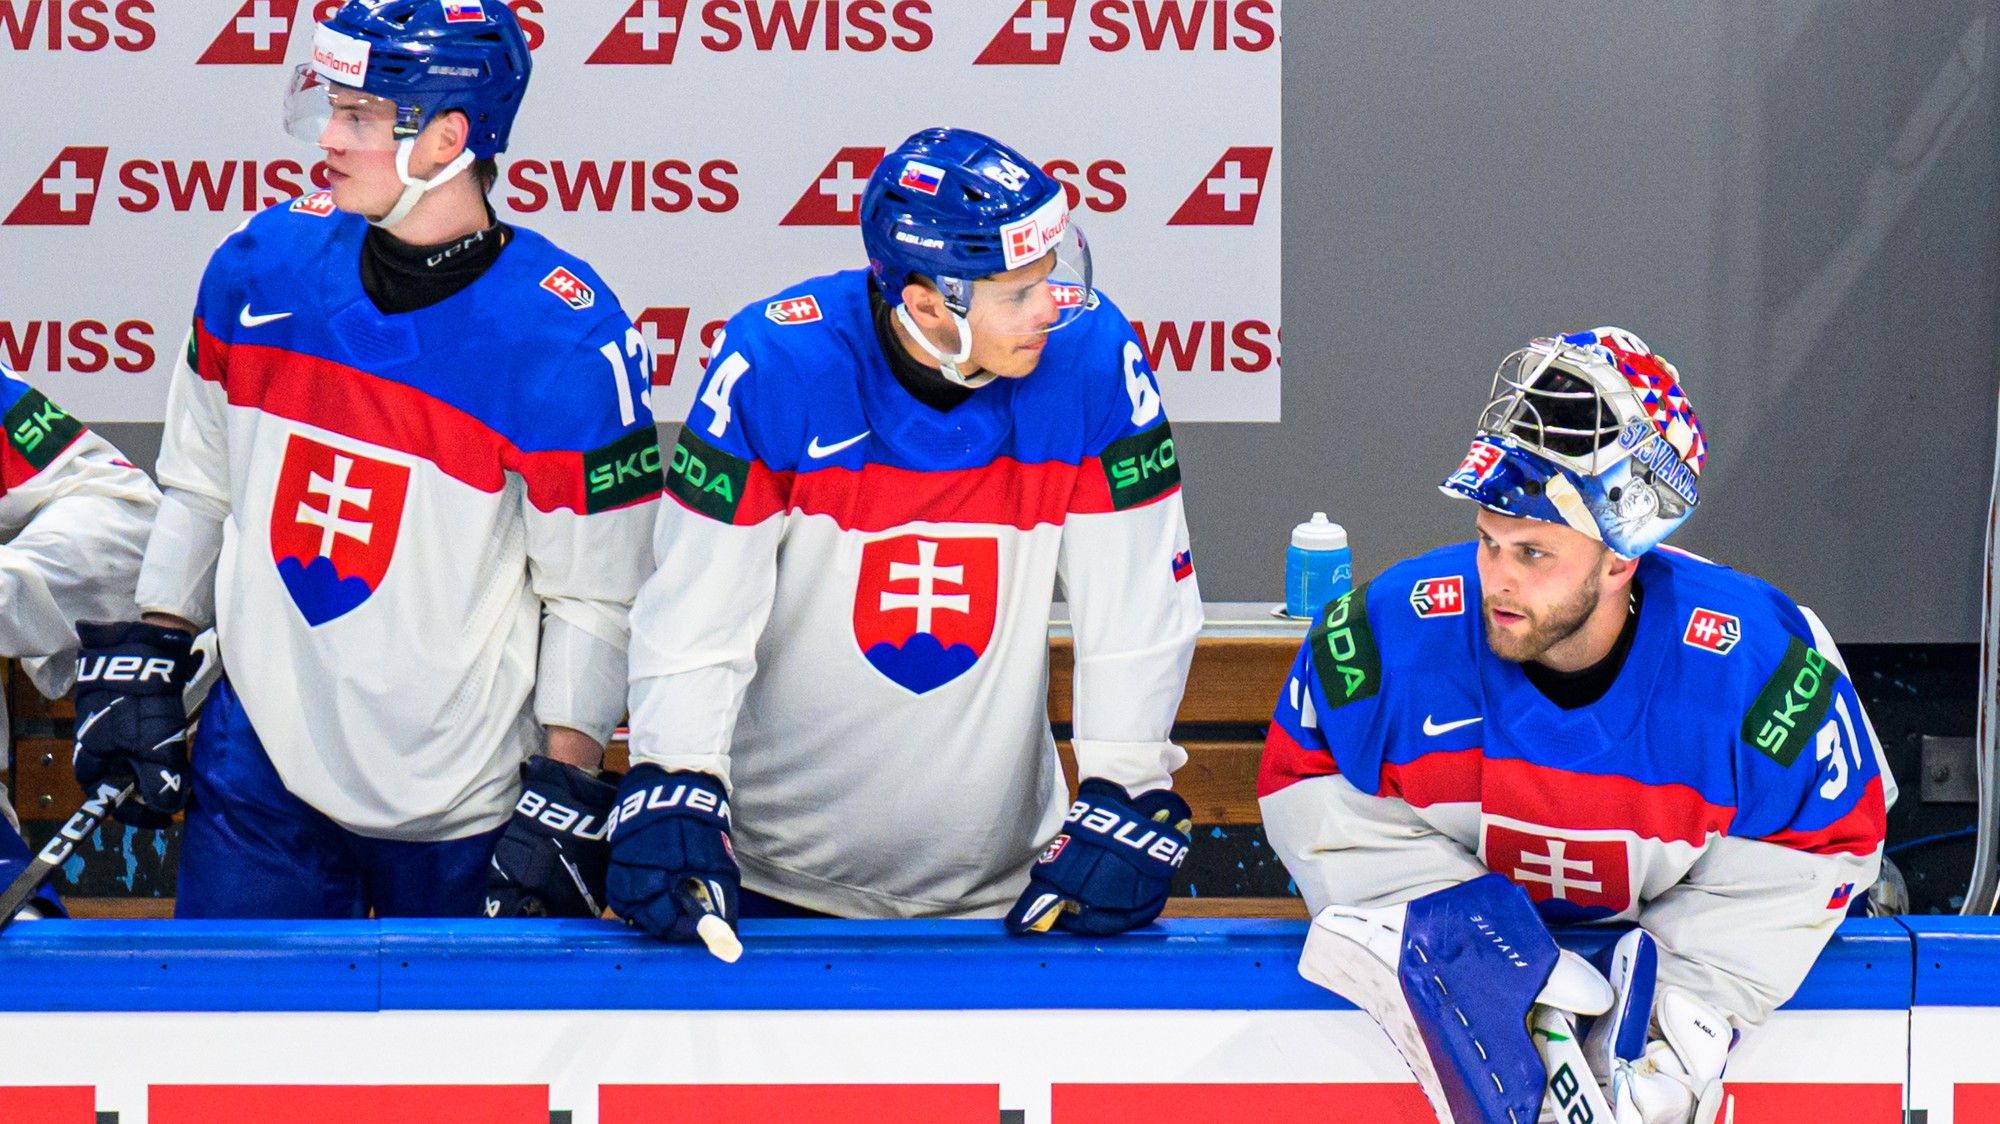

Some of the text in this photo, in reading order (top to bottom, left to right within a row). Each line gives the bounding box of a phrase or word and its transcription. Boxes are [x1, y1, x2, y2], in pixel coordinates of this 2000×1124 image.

[701, 0, 932, 52] SWISS
[1090, 0, 1281, 51] SWIS
[507, 159, 740, 212] SWISS
[983, 159, 1030, 192] 64
[427, 230, 484, 268] CCM
[1131, 320, 1281, 372] WIS
[701, 330, 750, 438] 4
[1619, 416, 1698, 505] SLOVAKIA
[76, 656, 176, 683] UER
[1816, 692, 1862, 800] 31
[38, 783, 121, 865] CCM
[1470, 915, 1528, 967] FLYLITE
